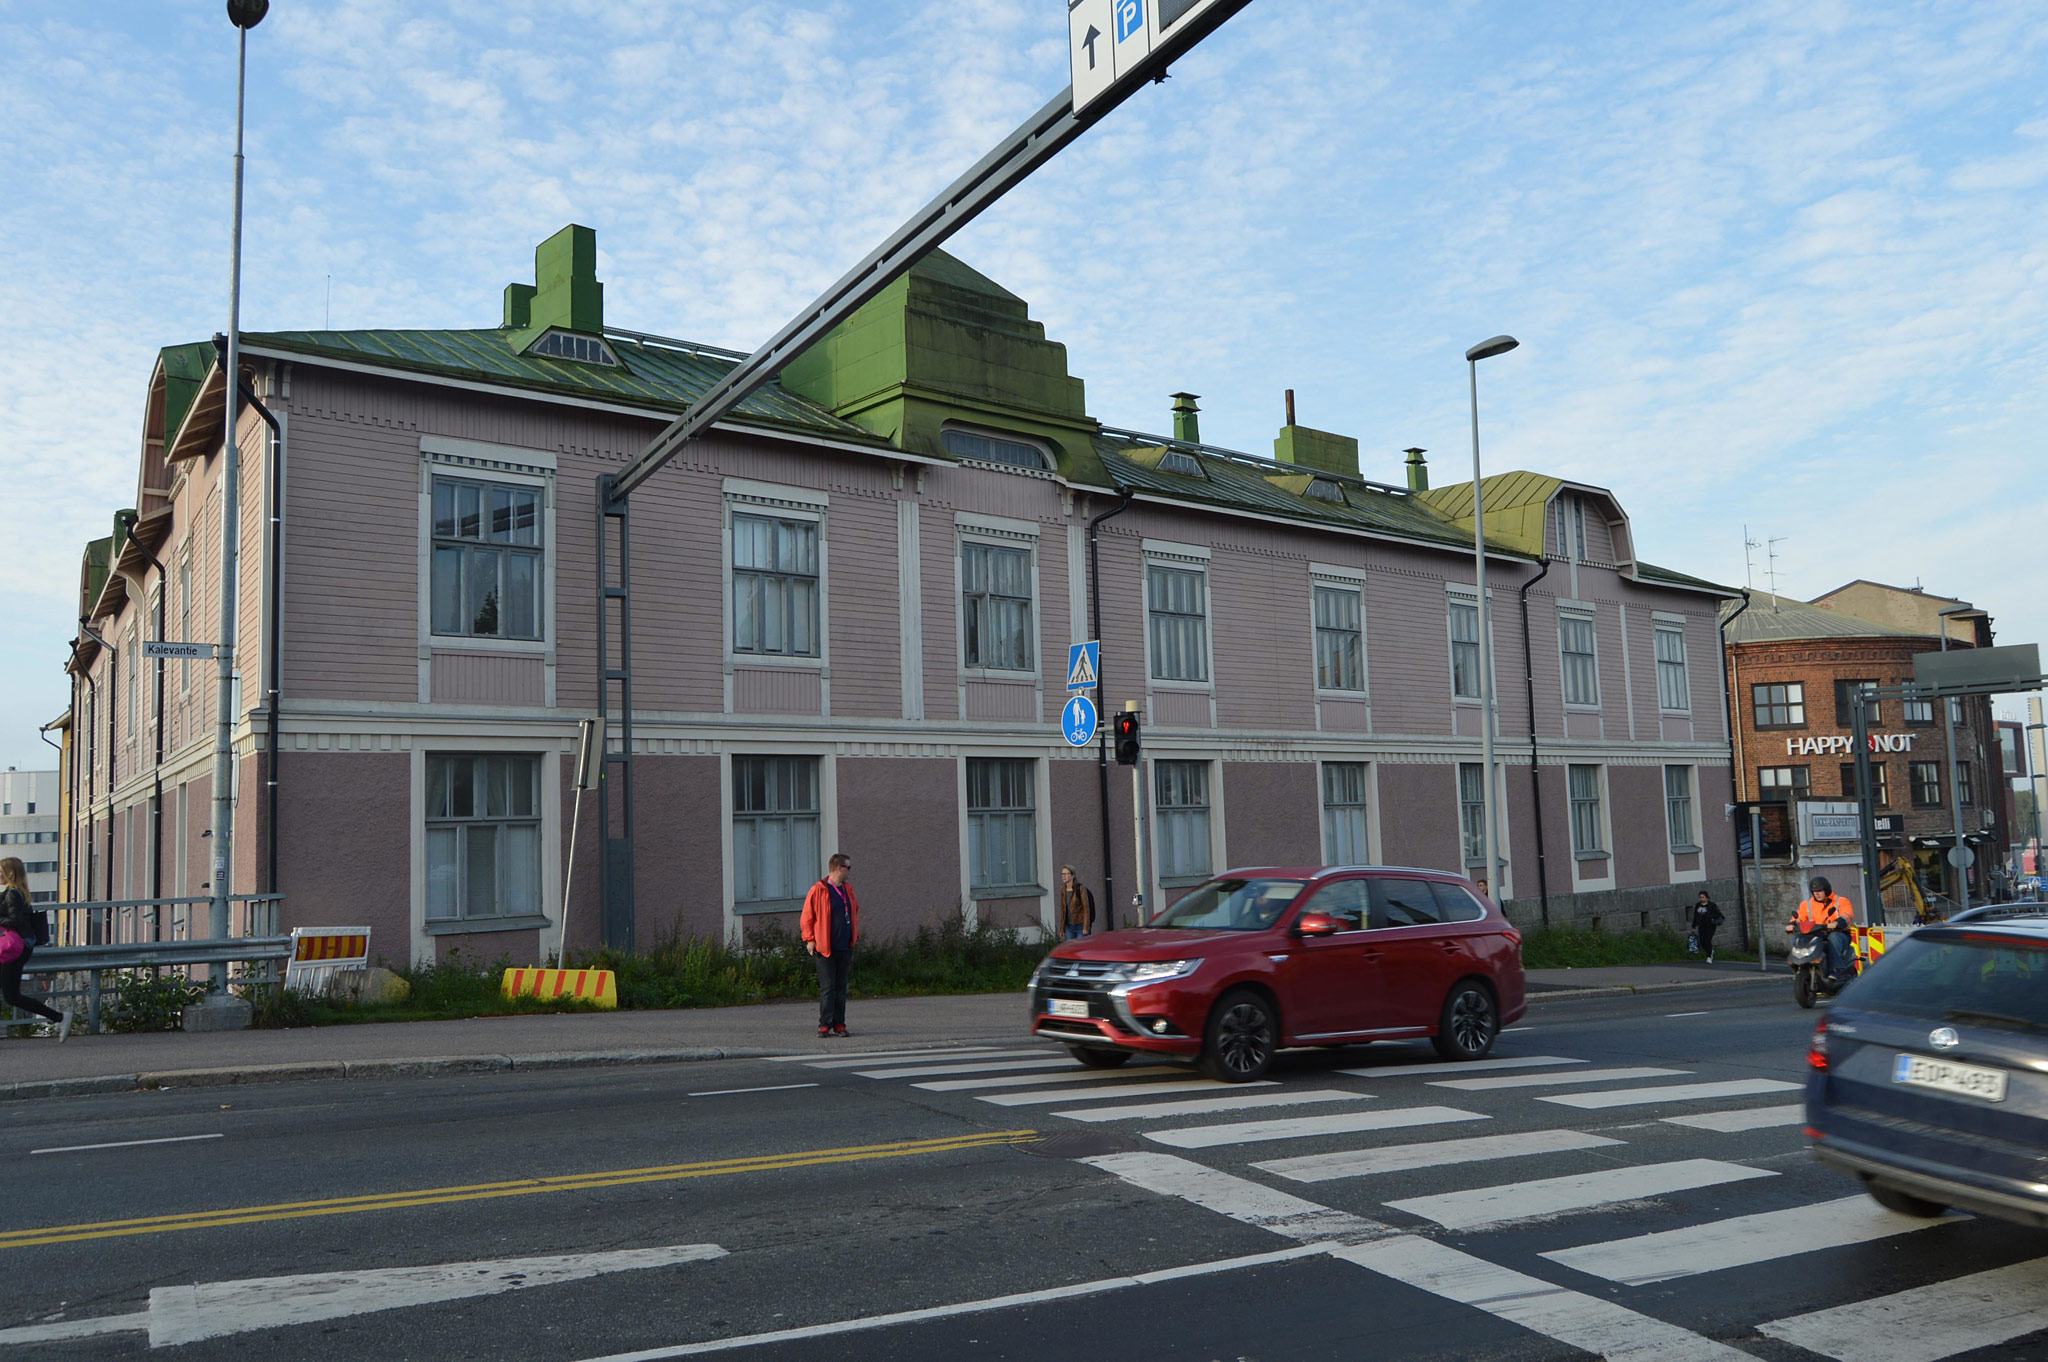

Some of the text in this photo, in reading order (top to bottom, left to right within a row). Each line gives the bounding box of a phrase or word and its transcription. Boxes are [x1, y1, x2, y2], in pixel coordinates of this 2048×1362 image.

[1123, 2, 1136, 38] P
[148, 644, 198, 656] Kalevantie
[1786, 735, 1854, 756] HAPPY
[1873, 733, 1914, 753] NOT
